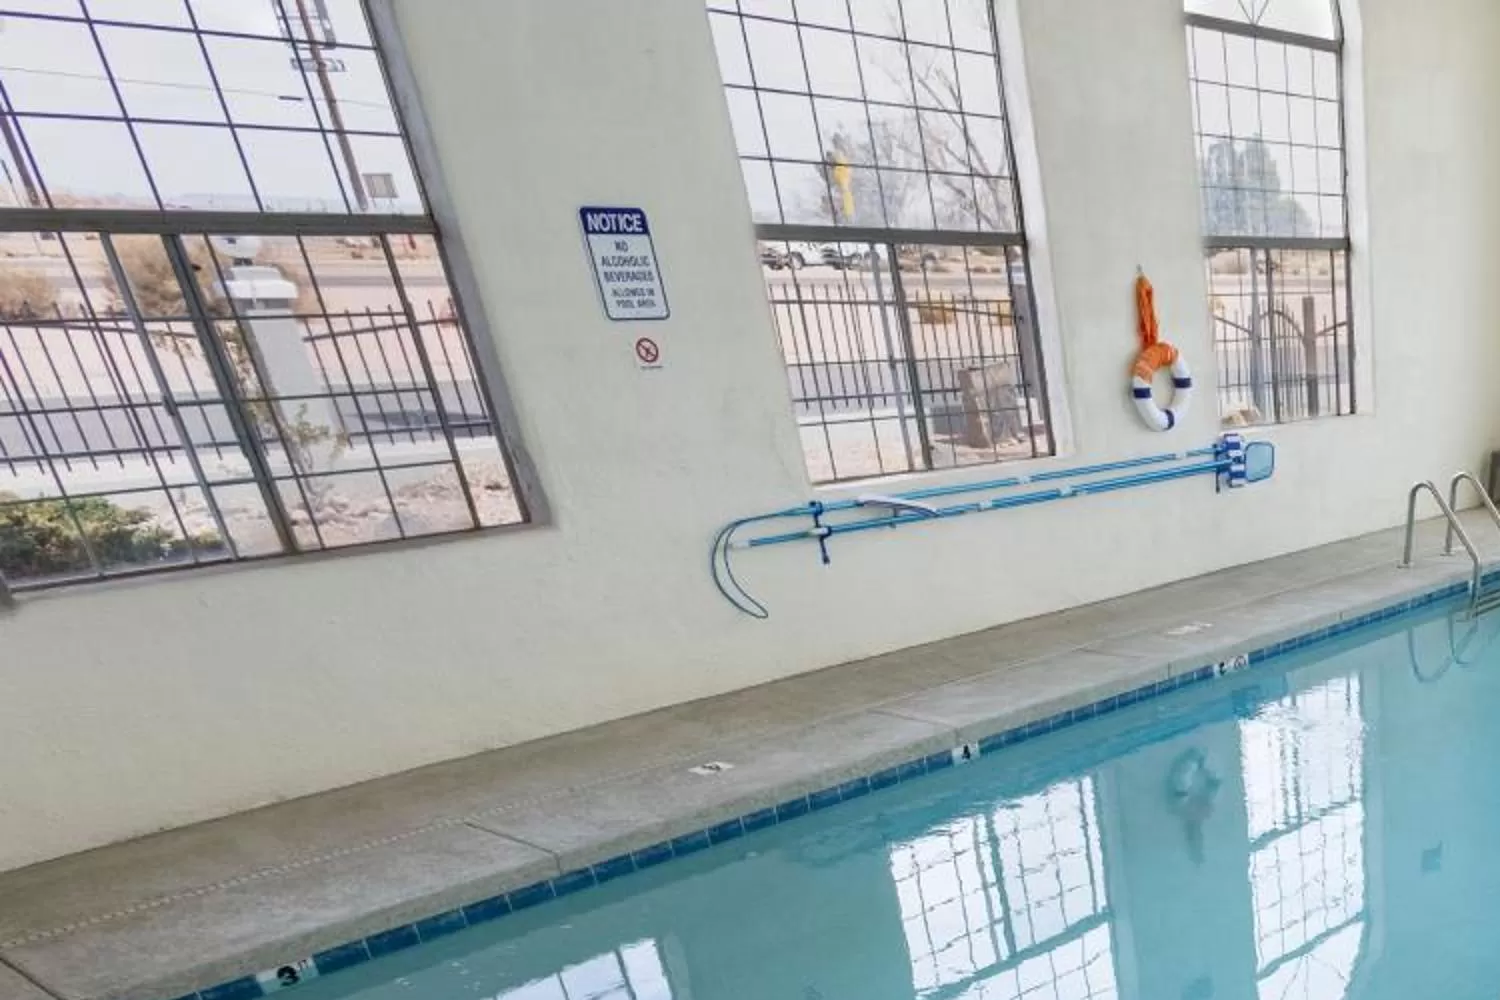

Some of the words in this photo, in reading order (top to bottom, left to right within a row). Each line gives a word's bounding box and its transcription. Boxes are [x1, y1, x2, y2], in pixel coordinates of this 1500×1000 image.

[587, 211, 643, 232] NOTICE
[614, 240, 628, 253] NO
[602, 255, 650, 267] ALCOHOLIC
[603, 271, 655, 283] BEVERAGES
[277, 966, 299, 986] 3
